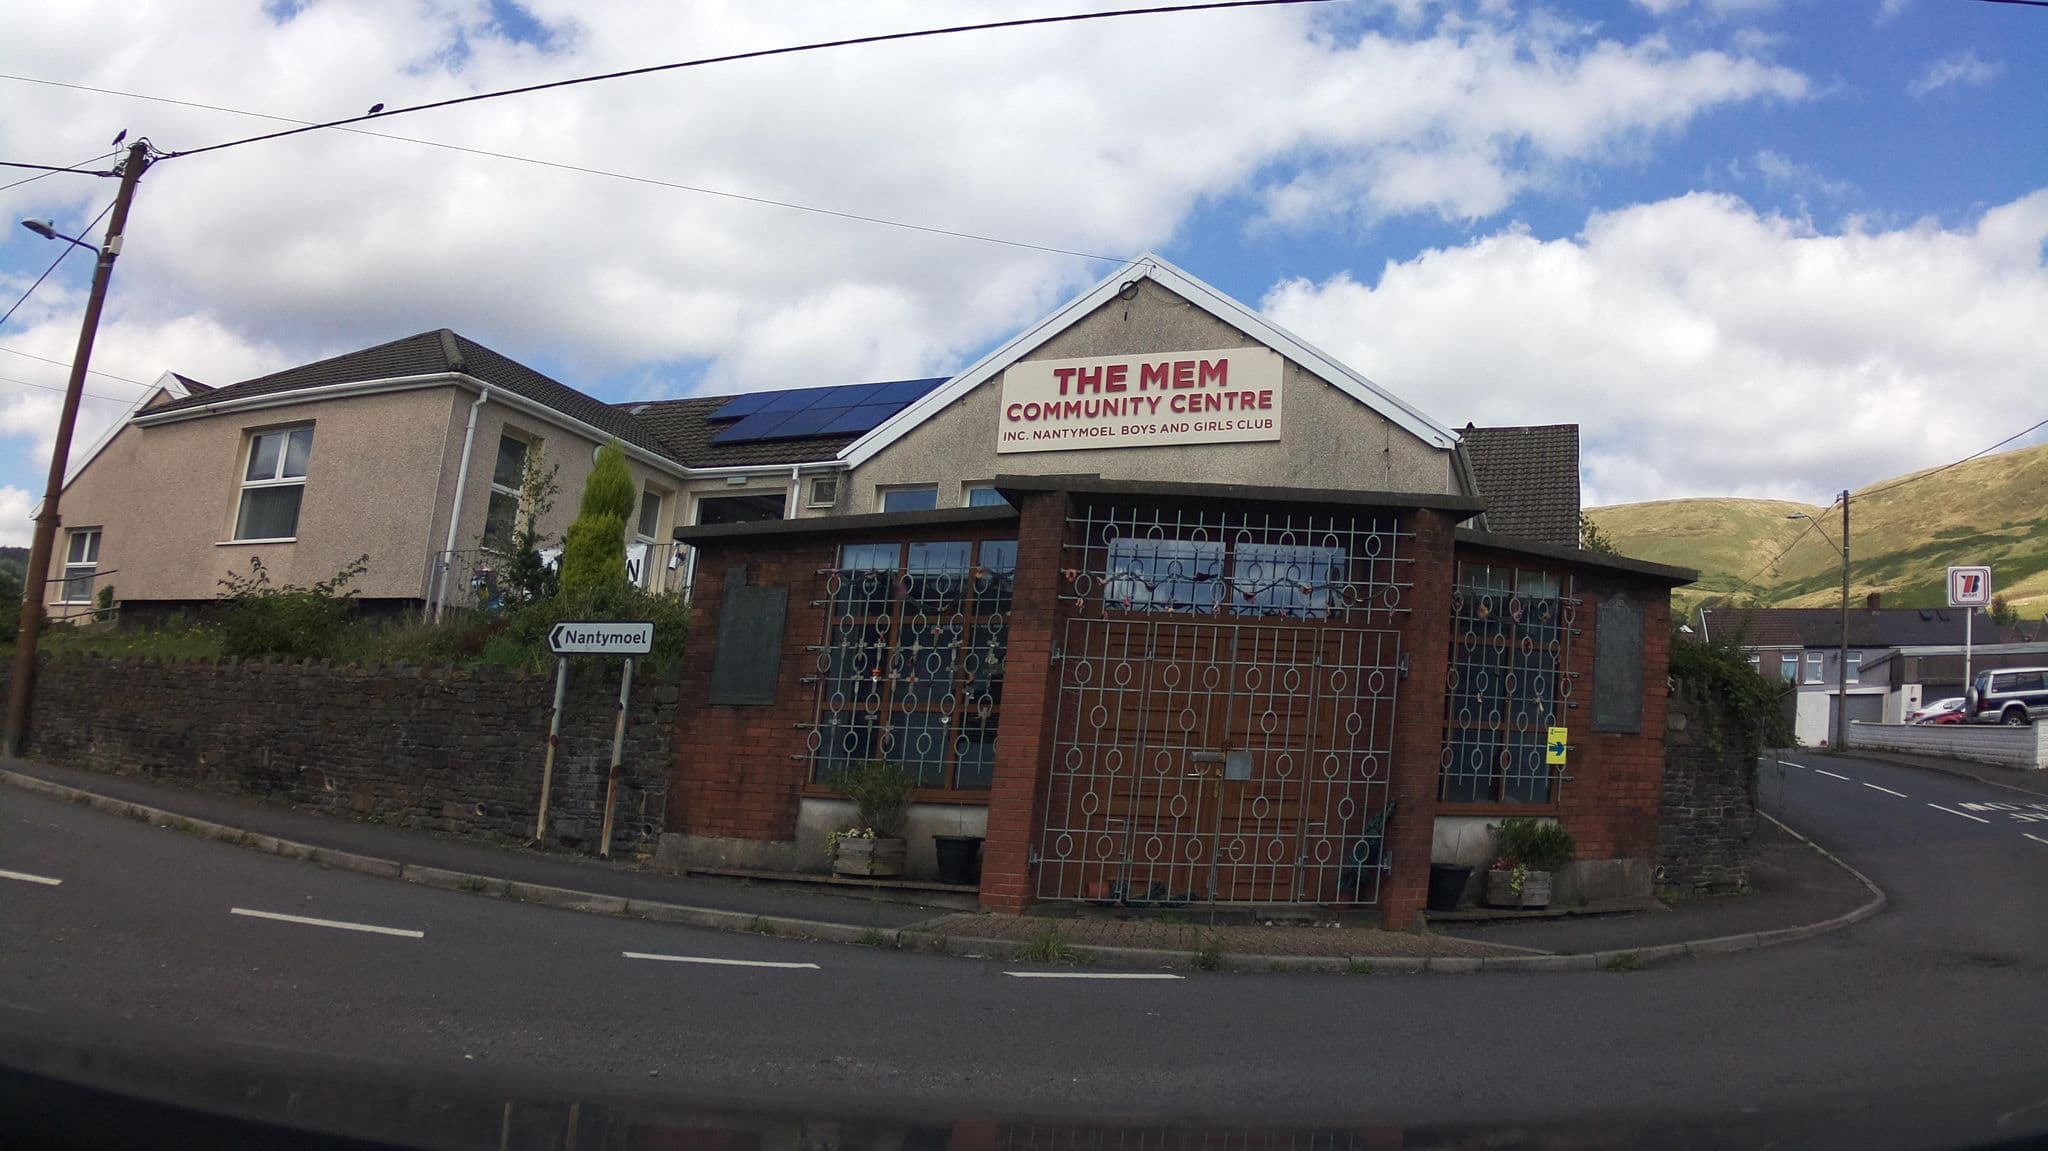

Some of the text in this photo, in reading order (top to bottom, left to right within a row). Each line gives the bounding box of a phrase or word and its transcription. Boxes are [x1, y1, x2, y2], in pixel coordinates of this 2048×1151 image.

[1054, 359, 1228, 395] THE MEM
[1006, 390, 1273, 422] COMMUNITY CENTRE
[1003, 418, 1273, 442] INC. NANTYMOEL BOYS AND GIRLS CLUB
[565, 630, 646, 646] Nantymoel
